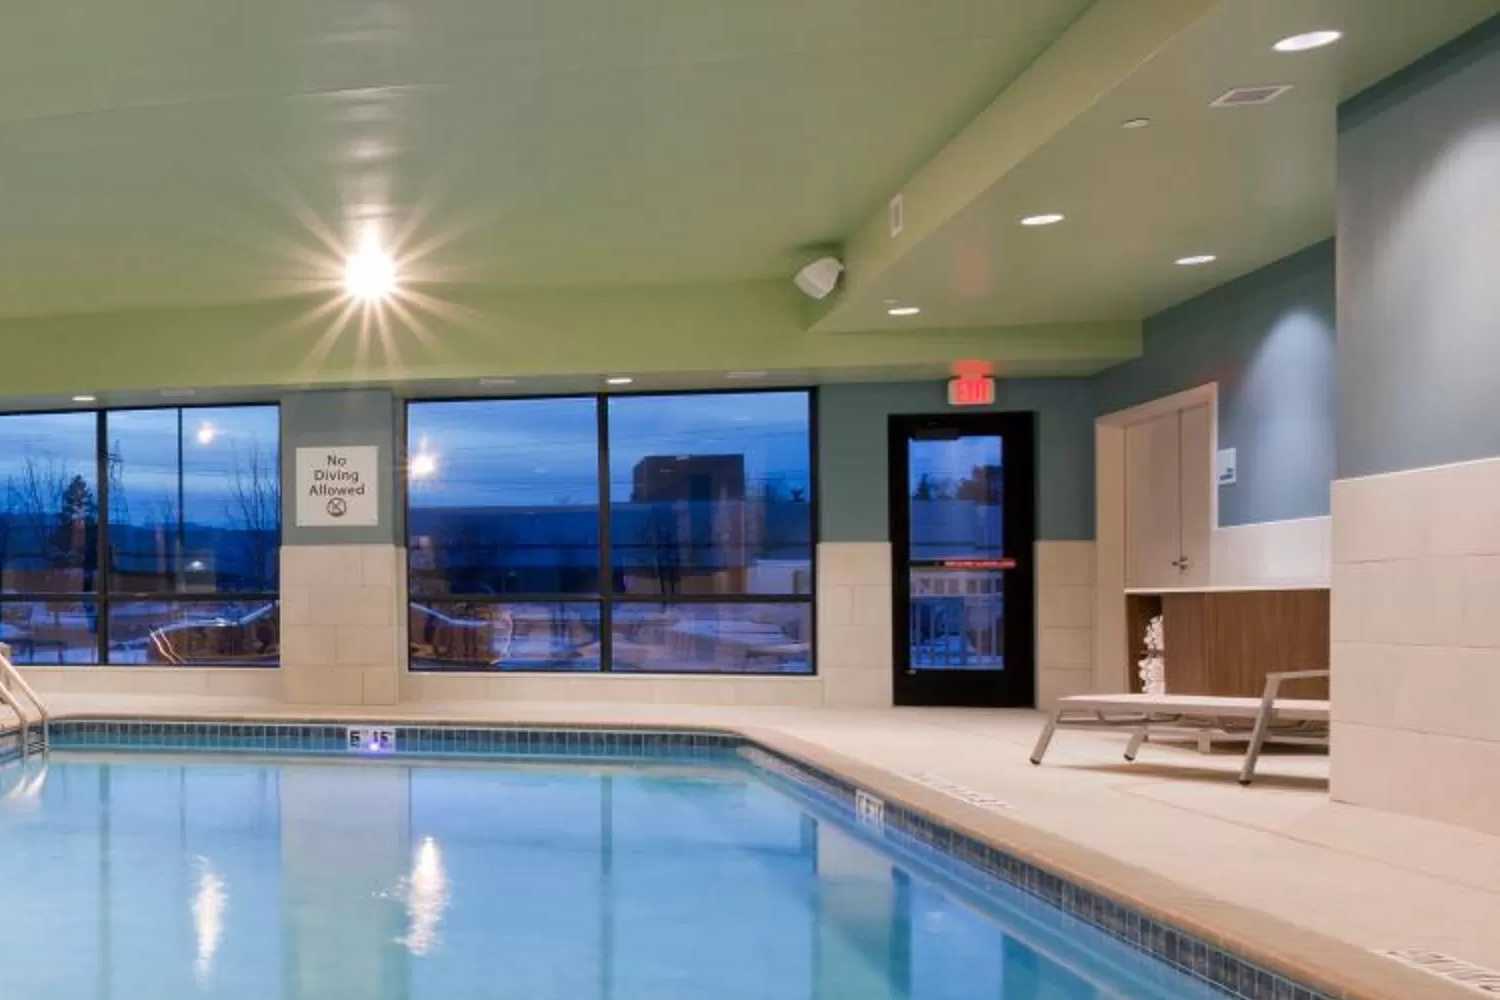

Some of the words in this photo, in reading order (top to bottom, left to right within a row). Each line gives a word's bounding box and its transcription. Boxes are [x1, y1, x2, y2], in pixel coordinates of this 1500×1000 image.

[327, 454, 348, 467] No
[313, 469, 360, 483] Diving
[308, 483, 366, 496] Allowed
